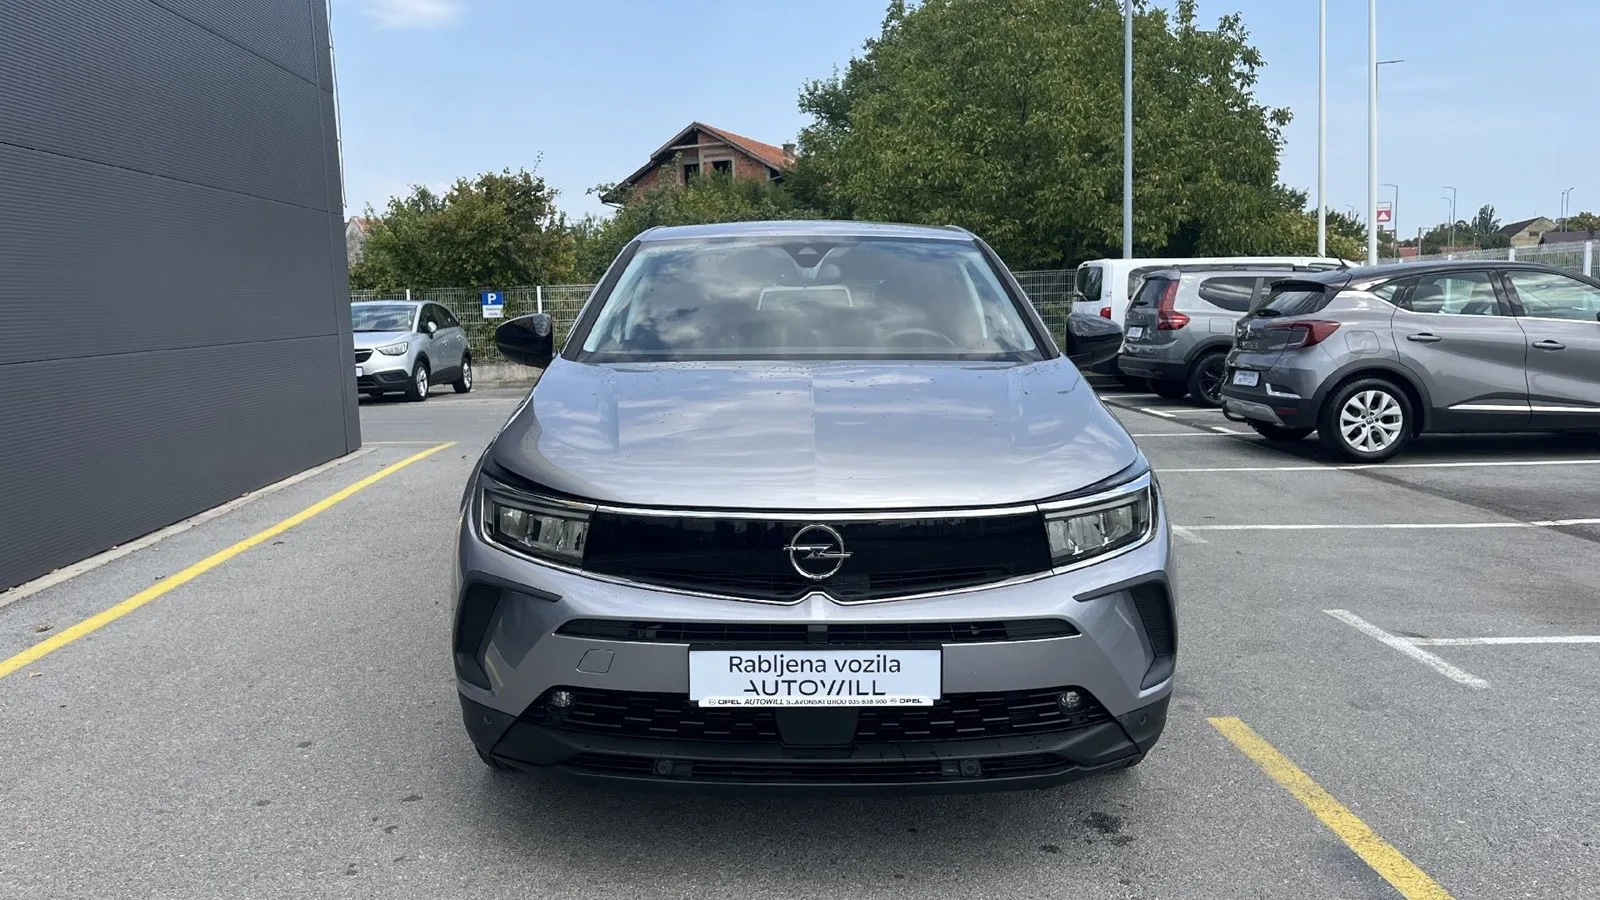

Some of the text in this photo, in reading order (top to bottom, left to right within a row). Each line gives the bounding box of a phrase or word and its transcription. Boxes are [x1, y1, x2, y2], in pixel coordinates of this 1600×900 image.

[487, 293, 497, 305] P
[729, 654, 901, 677] Rabljena vozila
[743, 679, 887, 696] AUTOWILL
